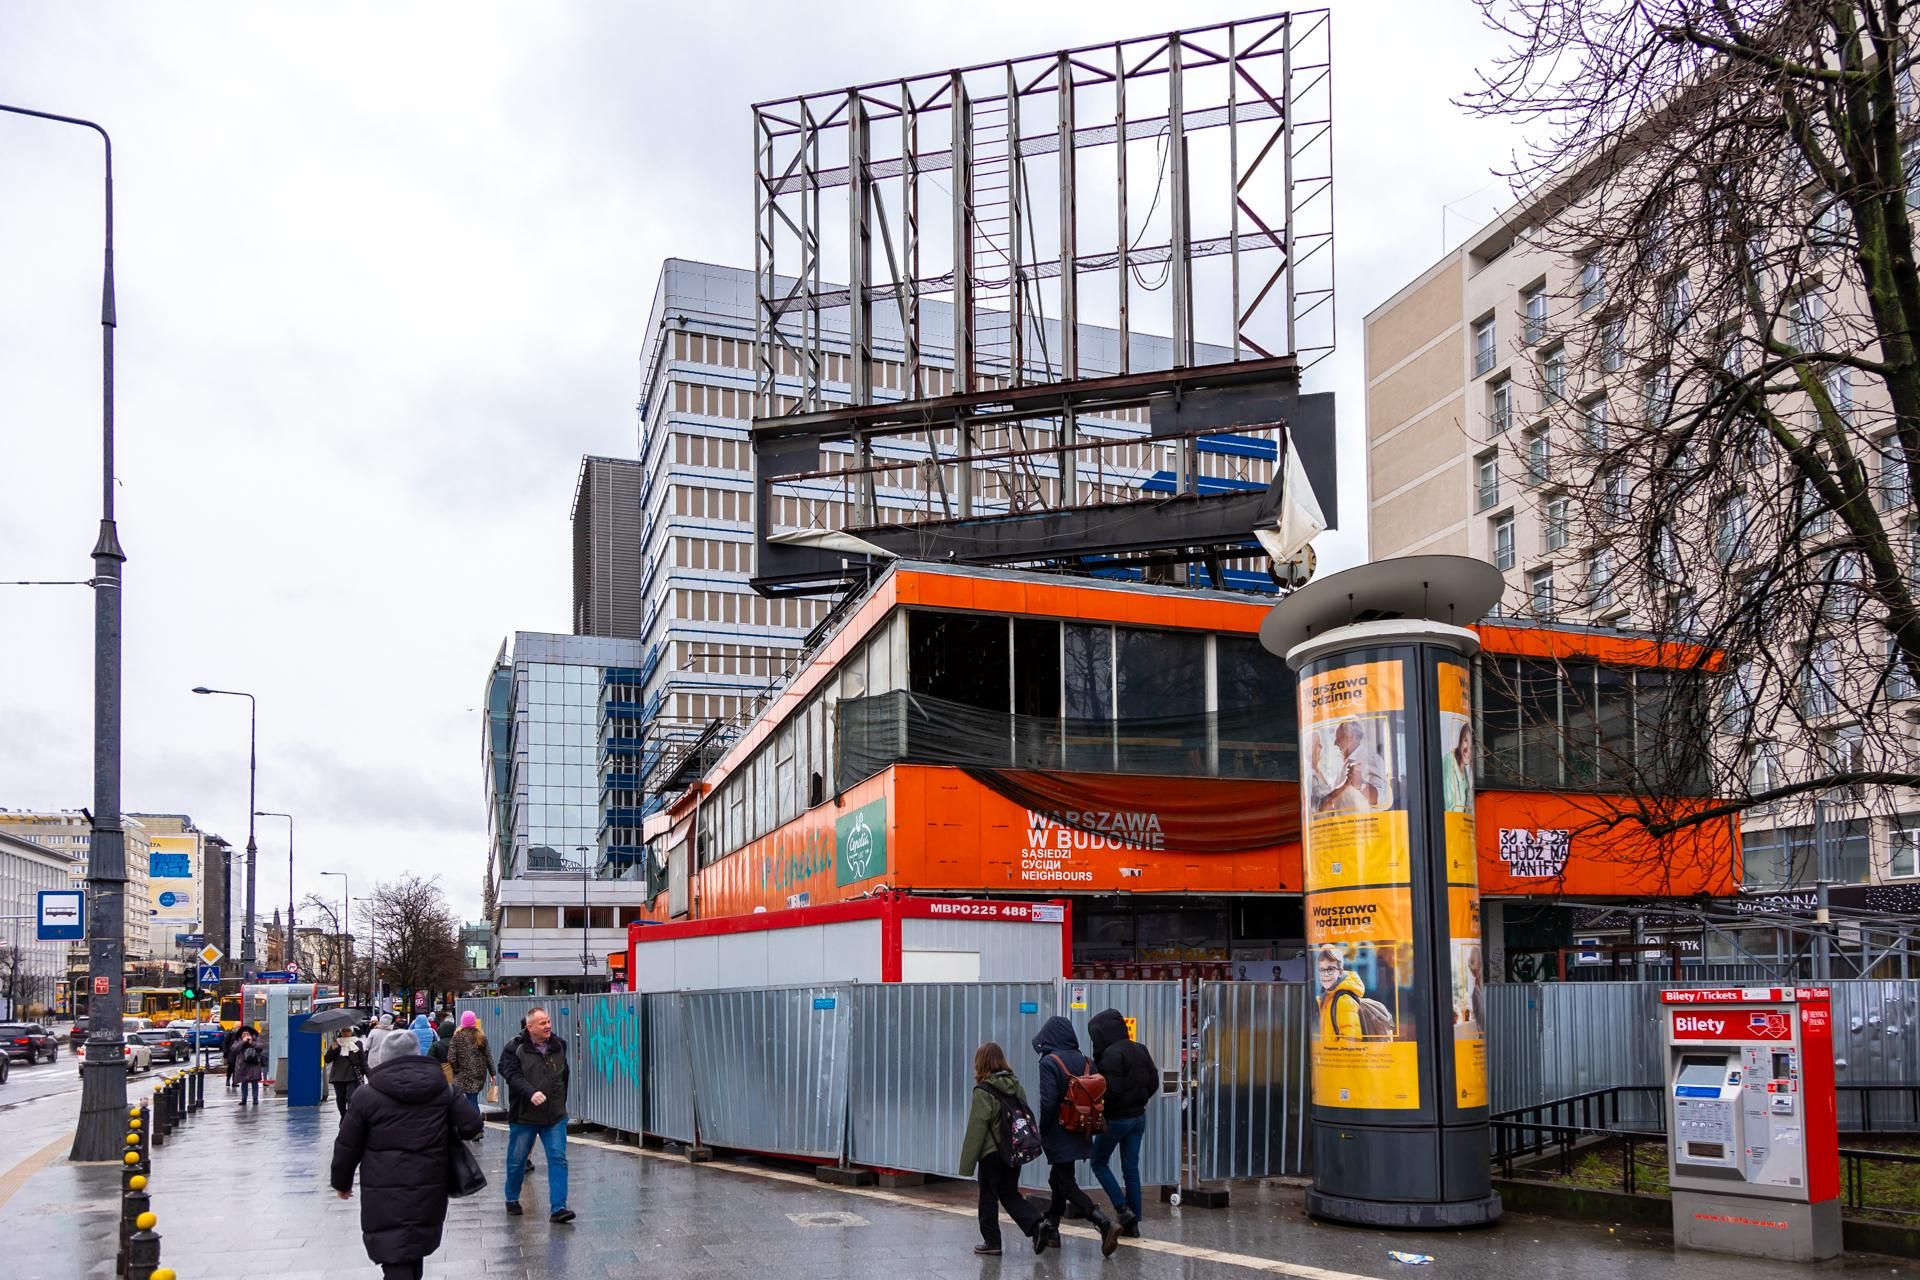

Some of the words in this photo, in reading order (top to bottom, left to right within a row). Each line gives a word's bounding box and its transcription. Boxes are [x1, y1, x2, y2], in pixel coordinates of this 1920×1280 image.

[1027, 809, 1161, 832] WARSZAWA
[1027, 829, 1049, 849] W
[1057, 829, 1165, 851] BUDOWIE
[1021, 848, 1072, 861] SĄSIEDZI
[1550, 845, 1568, 861] NA
[1021, 870, 1093, 881] NEIGHBOURS
[1313, 903, 1377, 918] Warszawa
[1316, 914, 1372, 929] rodzinna
[1666, 991, 1695, 1002] Bilety
[1703, 991, 1738, 1001] Tickets
[1675, 1017, 1725, 1035] Bilety
